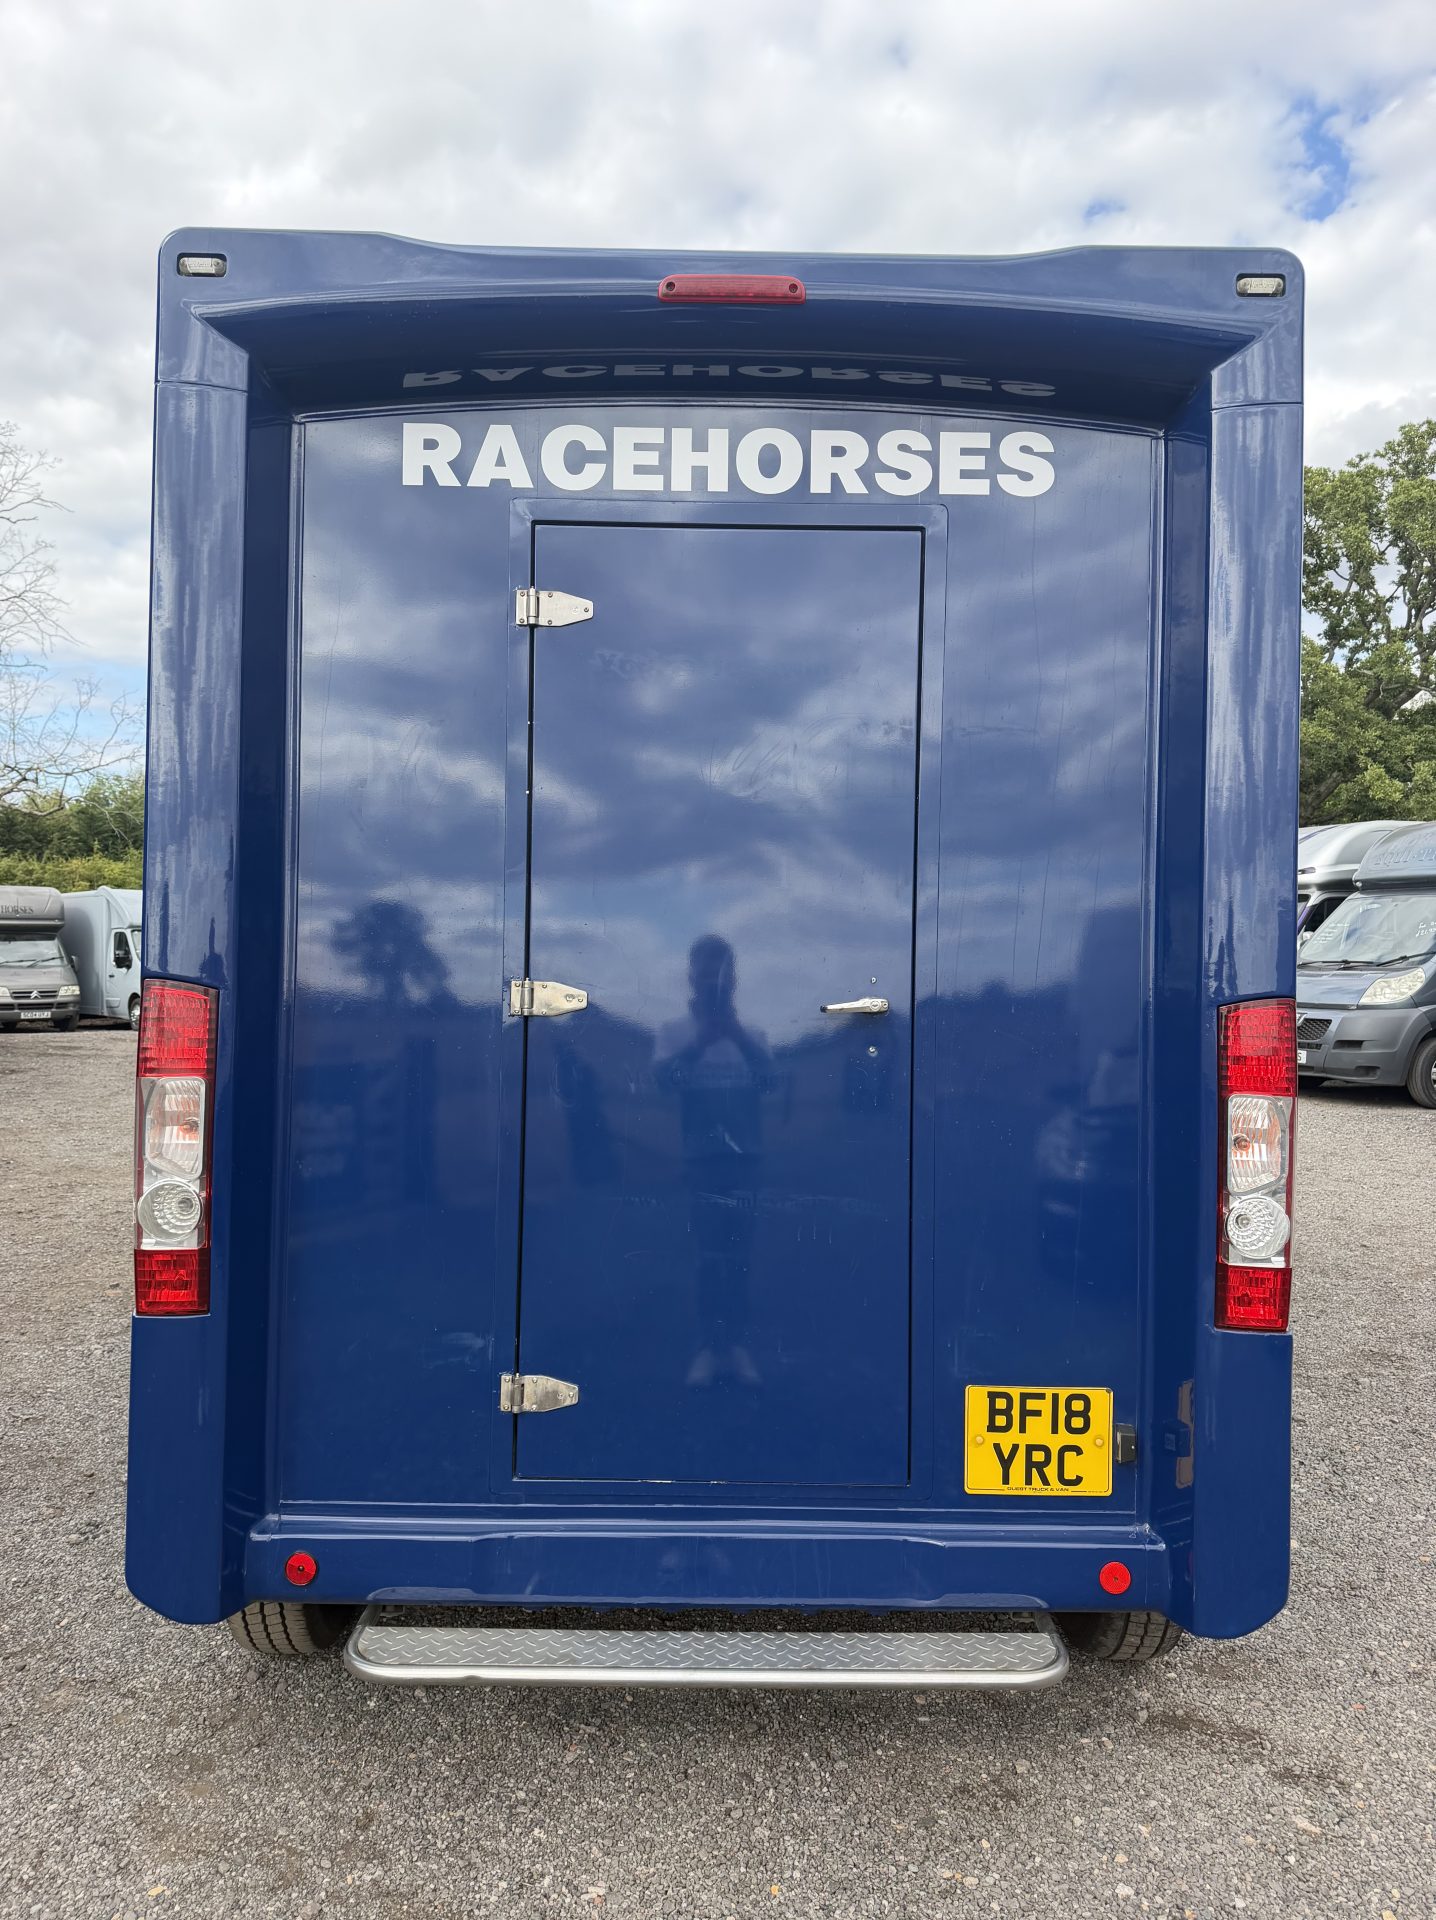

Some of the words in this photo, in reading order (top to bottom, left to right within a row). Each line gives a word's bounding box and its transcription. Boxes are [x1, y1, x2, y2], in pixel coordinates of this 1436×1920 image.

[401, 422, 1056, 497] RACEHORSES
[986, 1390, 1091, 1435] BF18
[992, 1442, 1084, 1487] YRC
